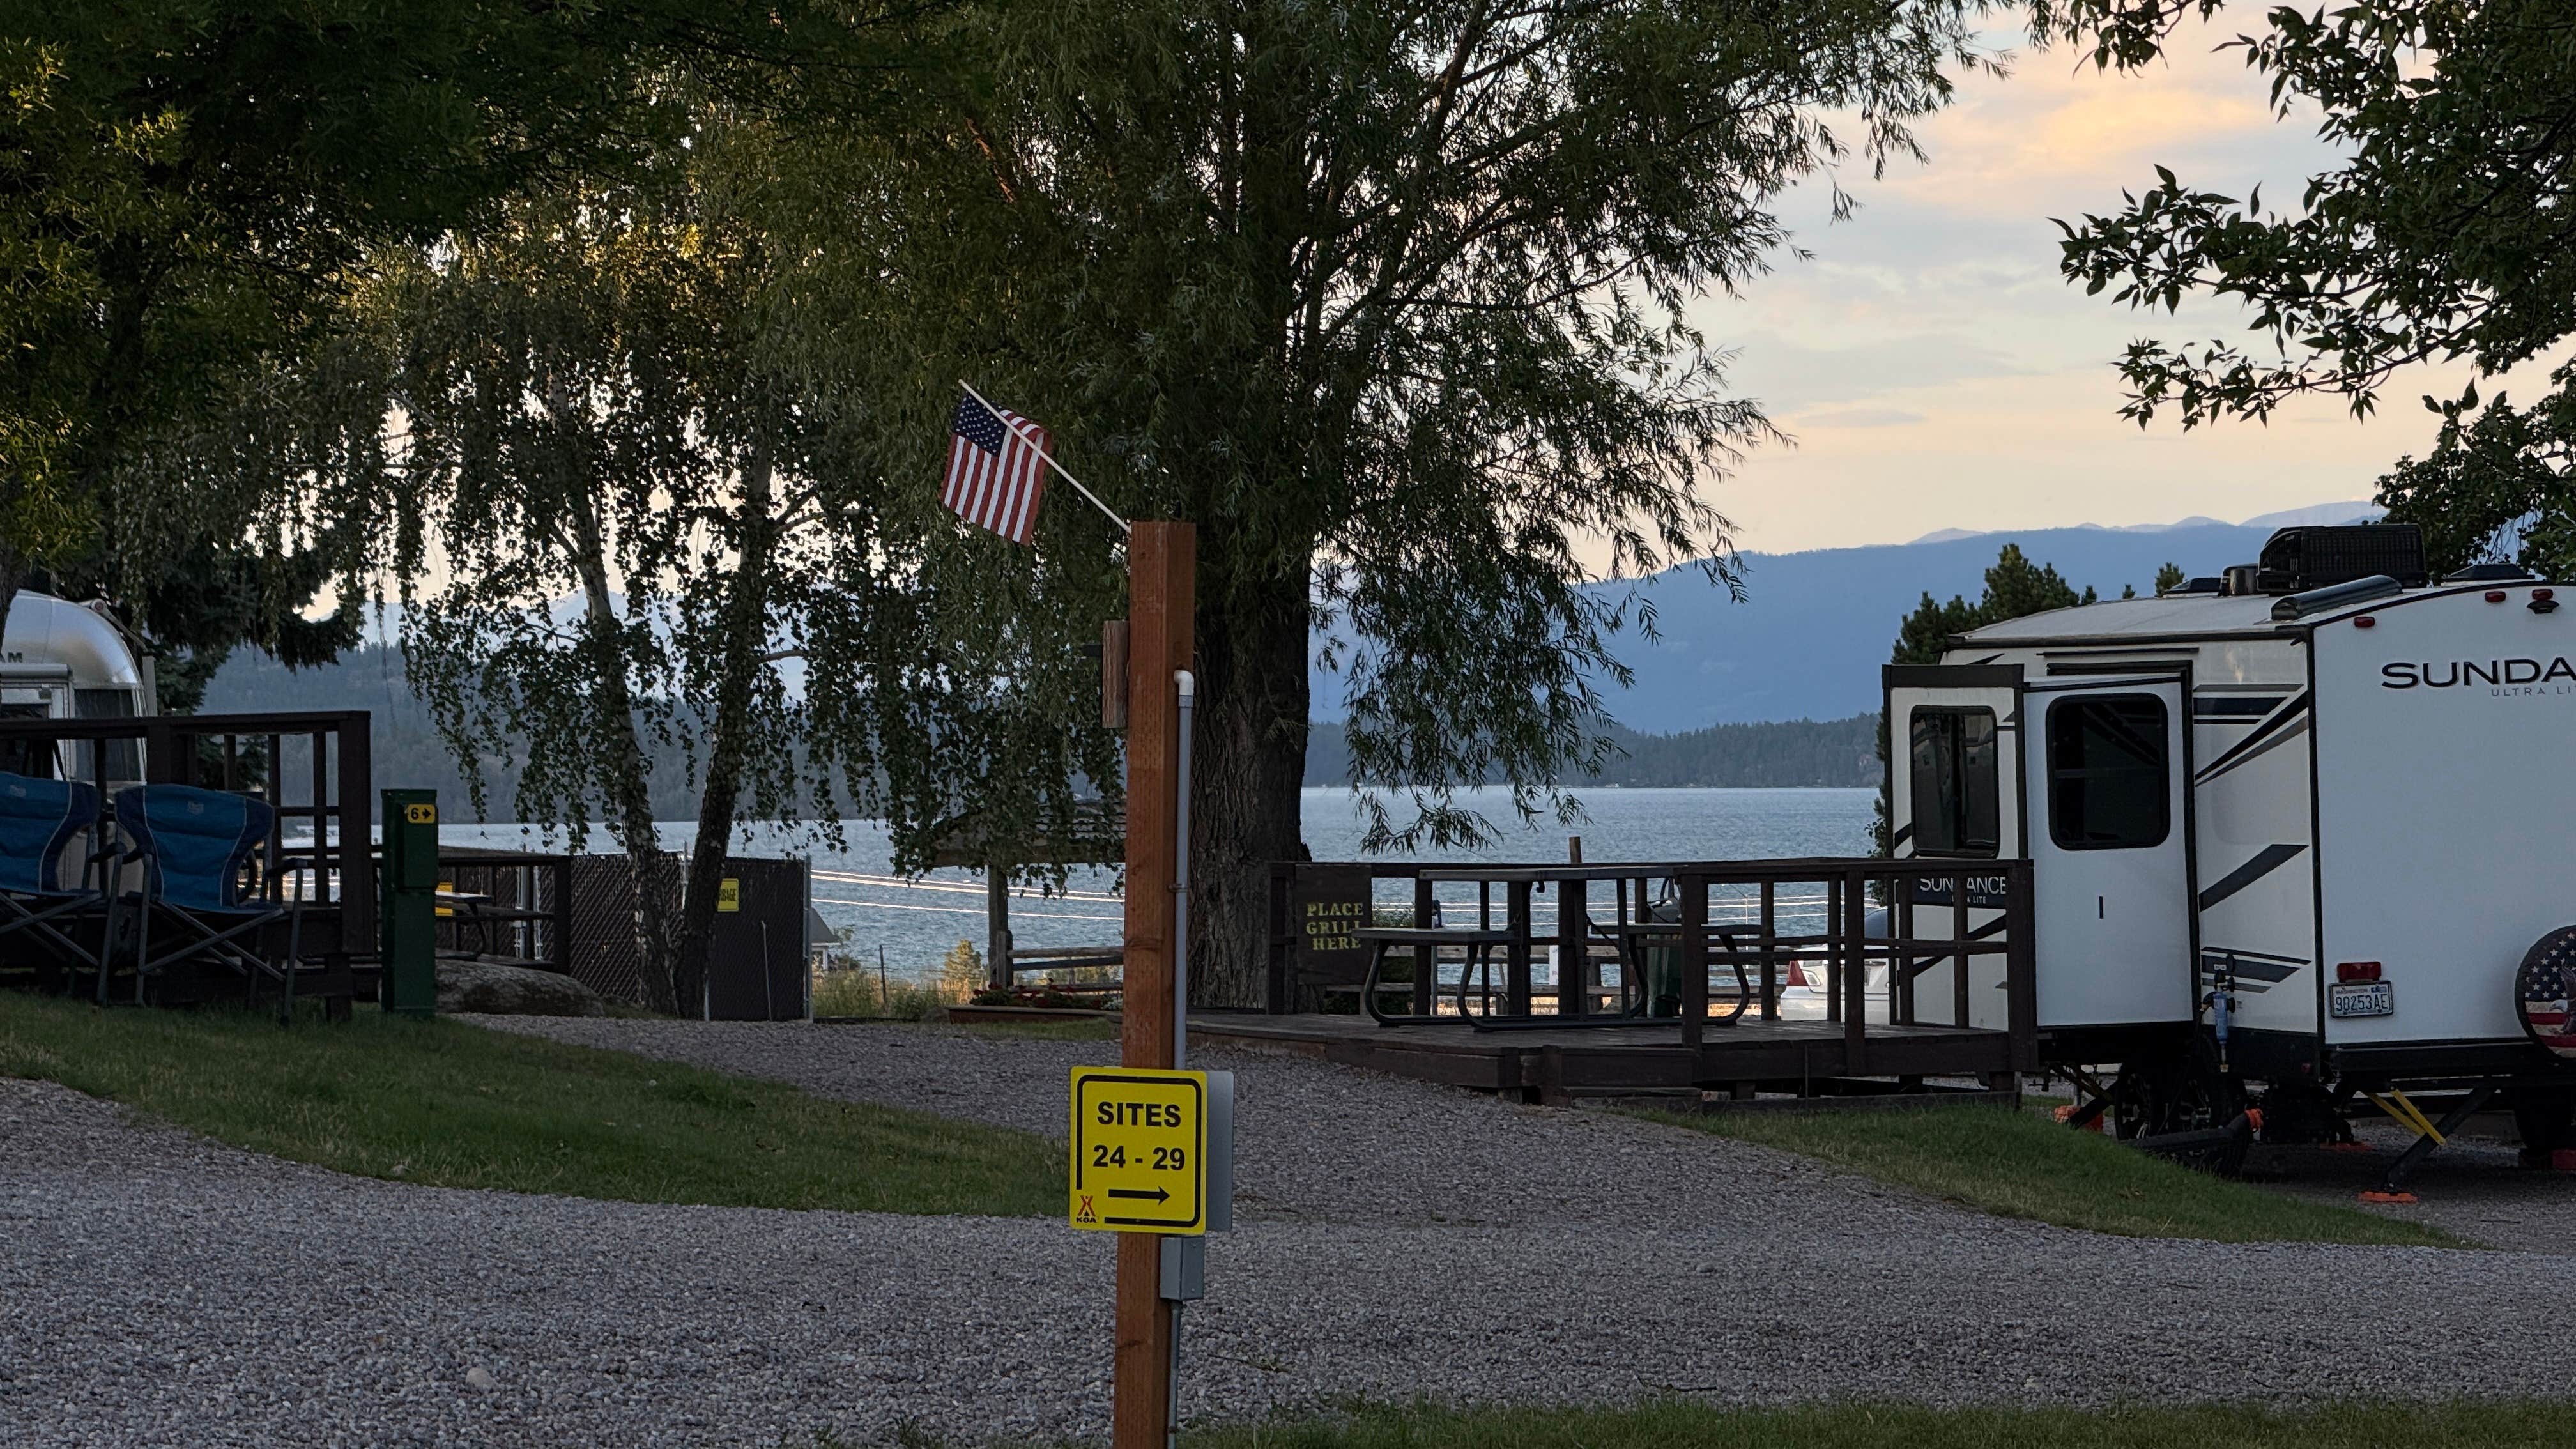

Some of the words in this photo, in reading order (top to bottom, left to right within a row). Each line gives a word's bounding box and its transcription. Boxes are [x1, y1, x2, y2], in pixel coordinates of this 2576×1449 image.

[2381, 657, 2576, 689] SUNDA
[2491, 687, 2546, 697] ULTRA
[2556, 686, 2576, 694] LI
[411, 807, 419, 820] 6
[1920, 877, 2007, 894] SUNANCE
[1973, 896, 1986, 904] LITE
[1307, 902, 1364, 916] PLACE
[1312, 937, 1361, 951] HERE
[1097, 1101, 1181, 1128] SITES
[1092, 1144, 1126, 1169] 24
[1152, 1147, 1185, 1170] 29
